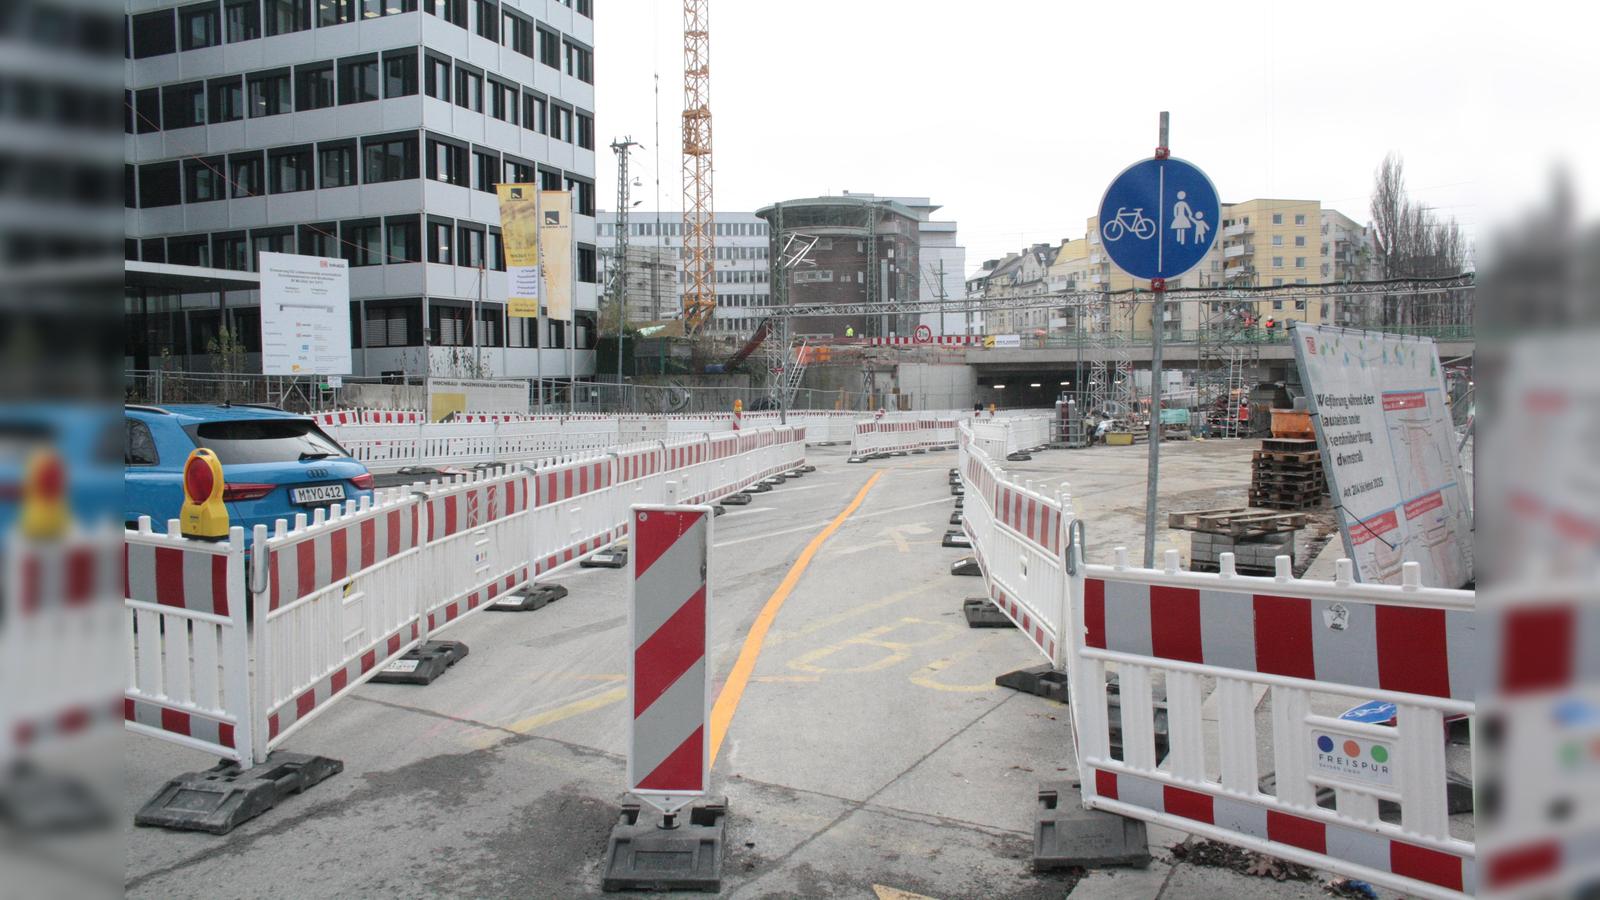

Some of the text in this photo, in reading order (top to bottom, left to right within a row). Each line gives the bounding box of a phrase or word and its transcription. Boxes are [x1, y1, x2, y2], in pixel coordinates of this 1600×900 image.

[298, 489, 306, 501] M
[325, 486, 341, 498] 412
[1319, 753, 1388, 773] FREISPUR
